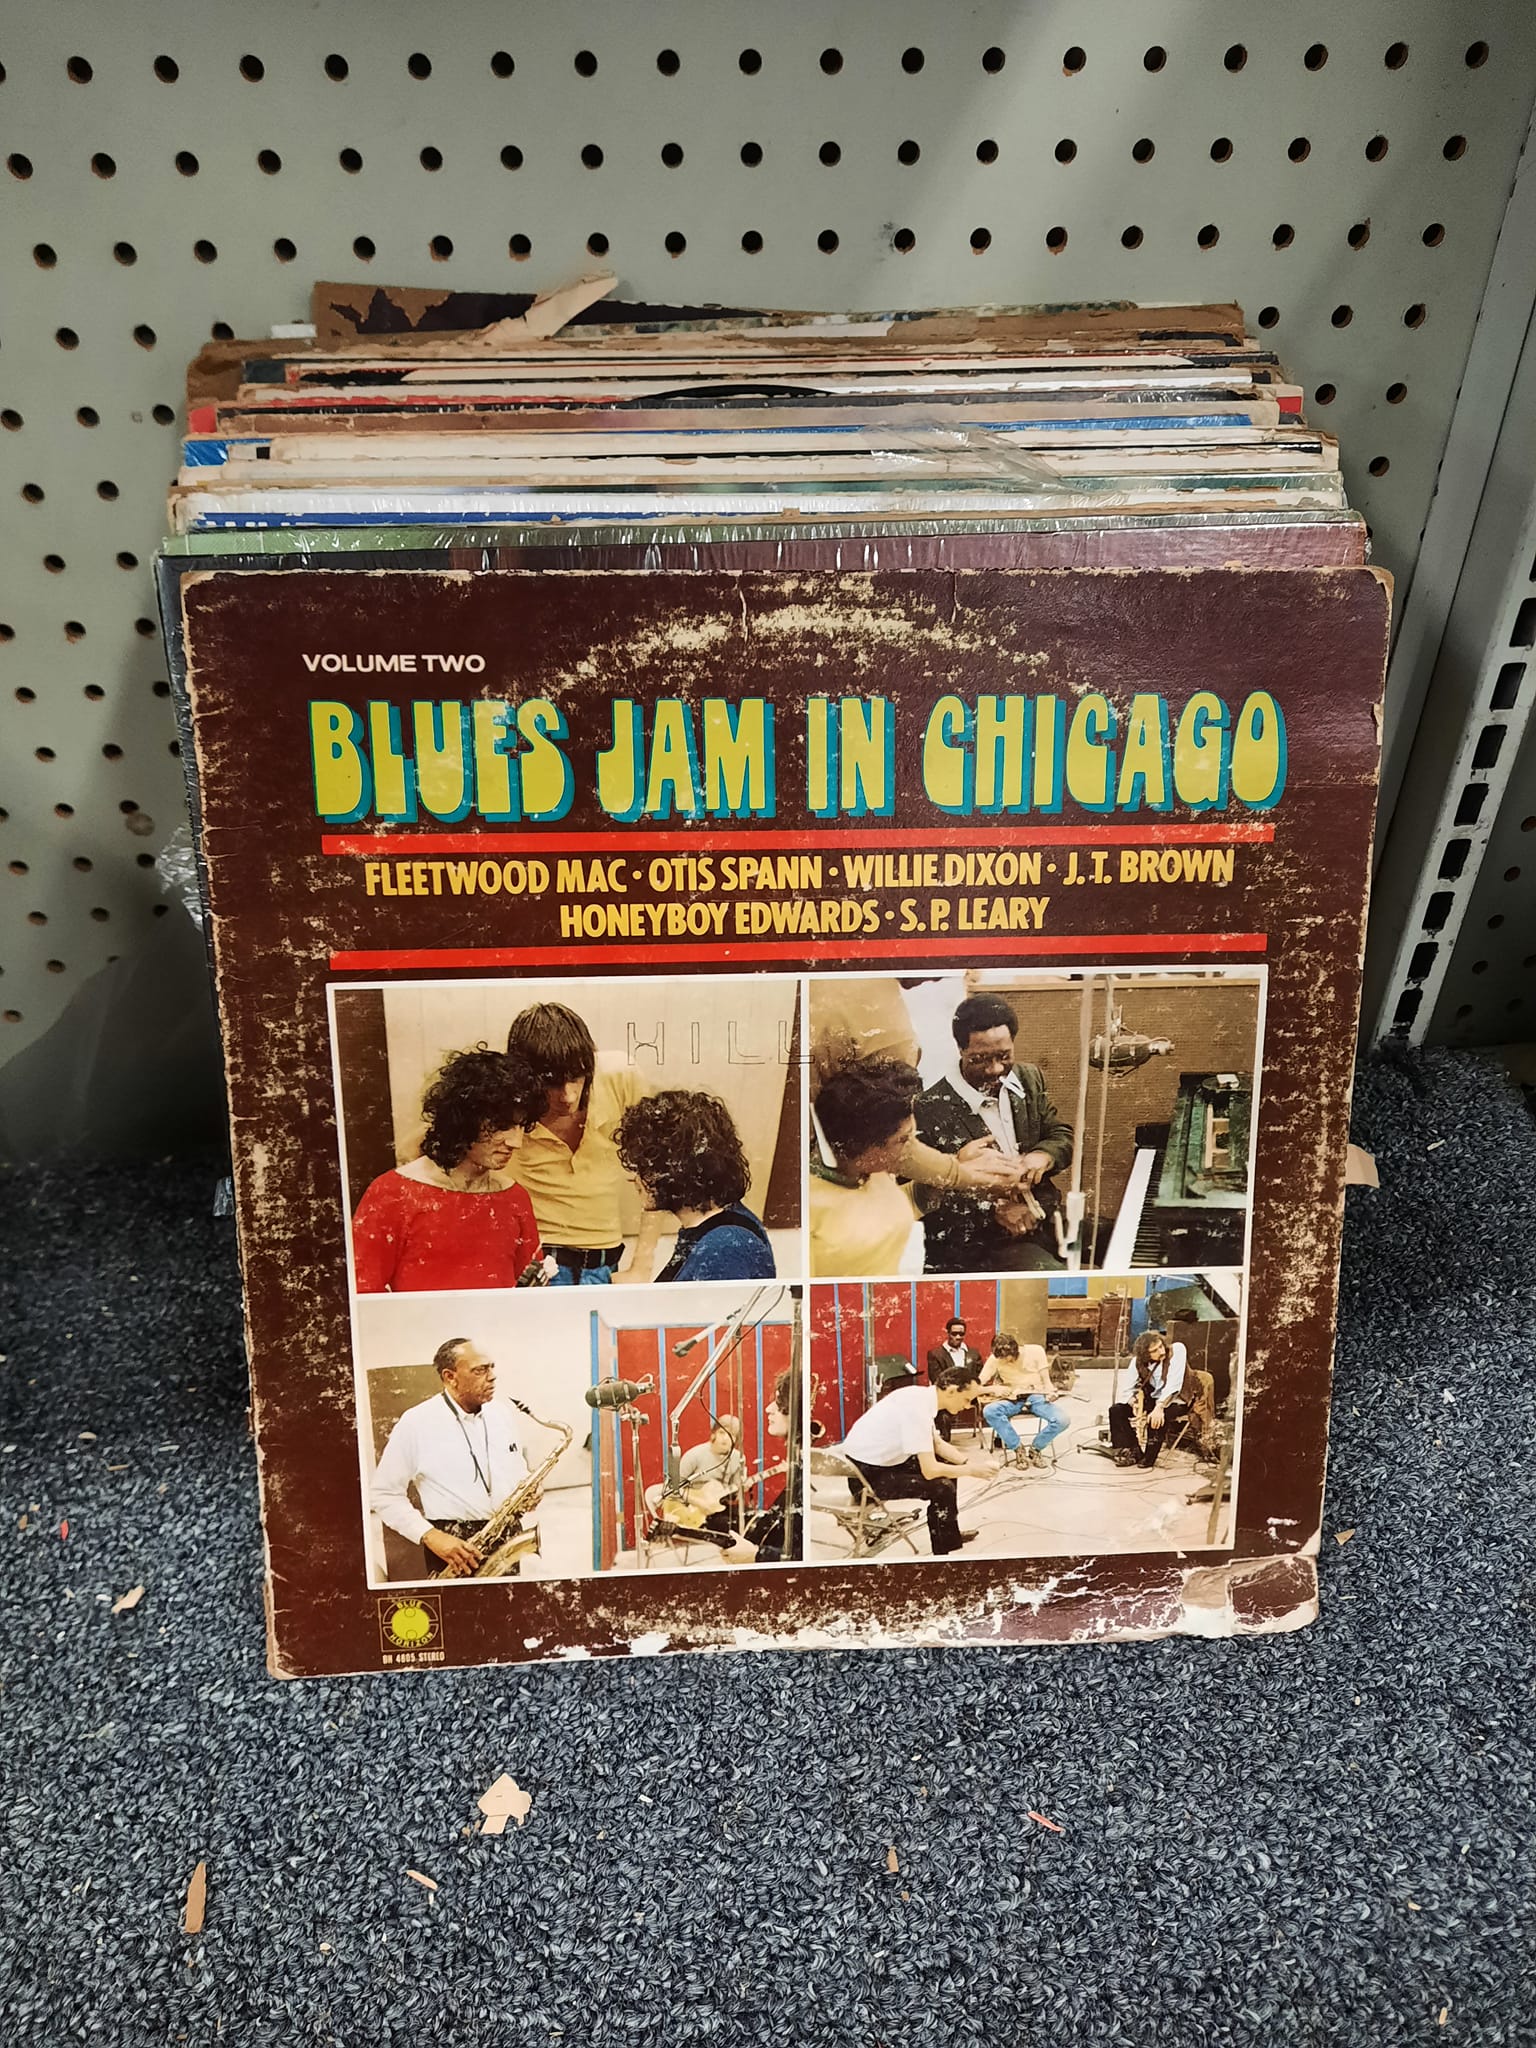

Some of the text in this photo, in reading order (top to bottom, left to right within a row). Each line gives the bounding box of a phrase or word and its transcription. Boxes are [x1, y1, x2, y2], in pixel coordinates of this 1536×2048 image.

[302, 654, 486, 673] VOLUME TWO
[309, 691, 1289, 825] BLUES JAM IN CHICAGO
[364, 859, 550, 896] FLEETWOOD
[556, 858, 627, 894] MAC
[648, 857, 716, 892] OTIS
[720, 855, 823, 891] SPANN
[842, 853, 938, 889] WILLIE
[945, 852, 1043, 887] DIXON
[1119, 849, 1235, 884] BROWN
[560, 903, 730, 938] HONEYBOY
[735, 898, 880, 936] EDWARDS
[958, 896, 1051, 931] LEARY
[626, 1020, 815, 1065] HILL
[396, 1599, 423, 1609] BLUE
[418, 1651, 445, 1662] STEREO
